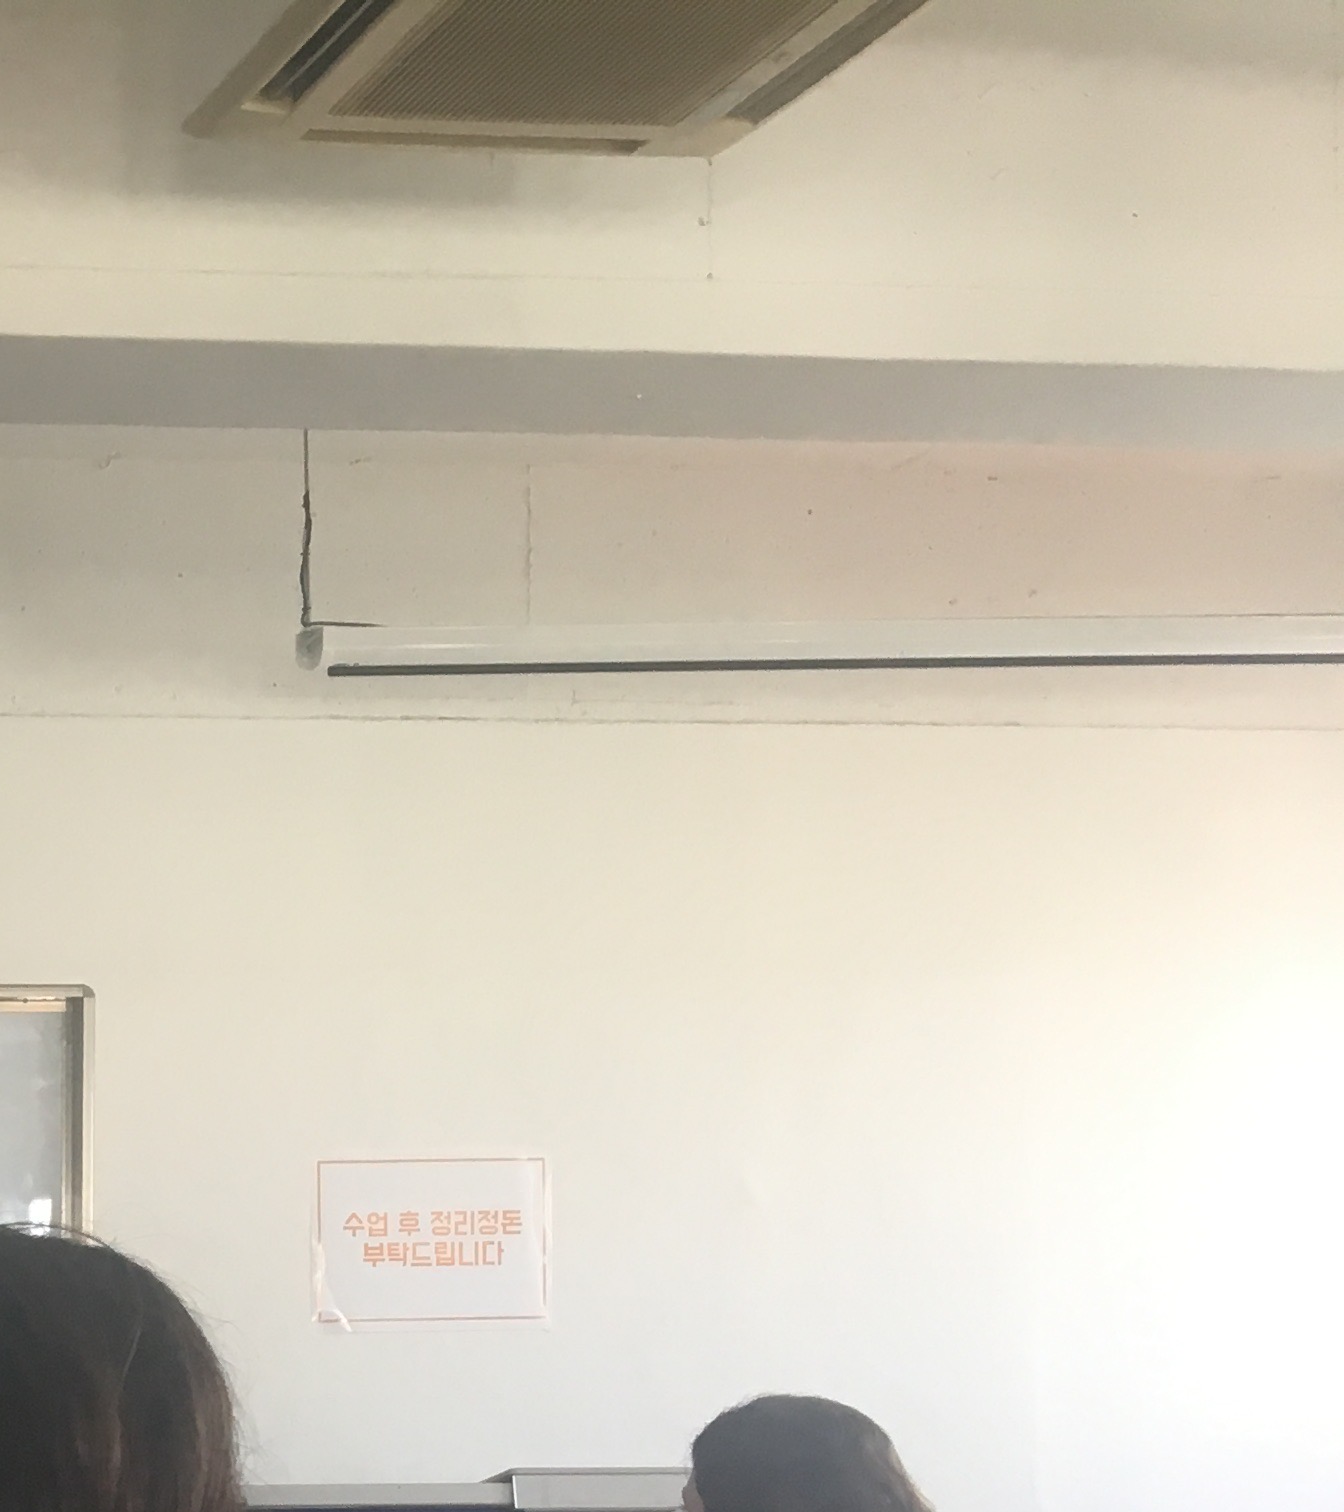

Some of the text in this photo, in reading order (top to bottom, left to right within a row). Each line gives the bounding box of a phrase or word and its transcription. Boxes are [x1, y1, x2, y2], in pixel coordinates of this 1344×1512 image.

[343, 1209, 523, 1237] 수업 후 정리정돈
[363, 1240, 505, 1267] 부탁드립니다
